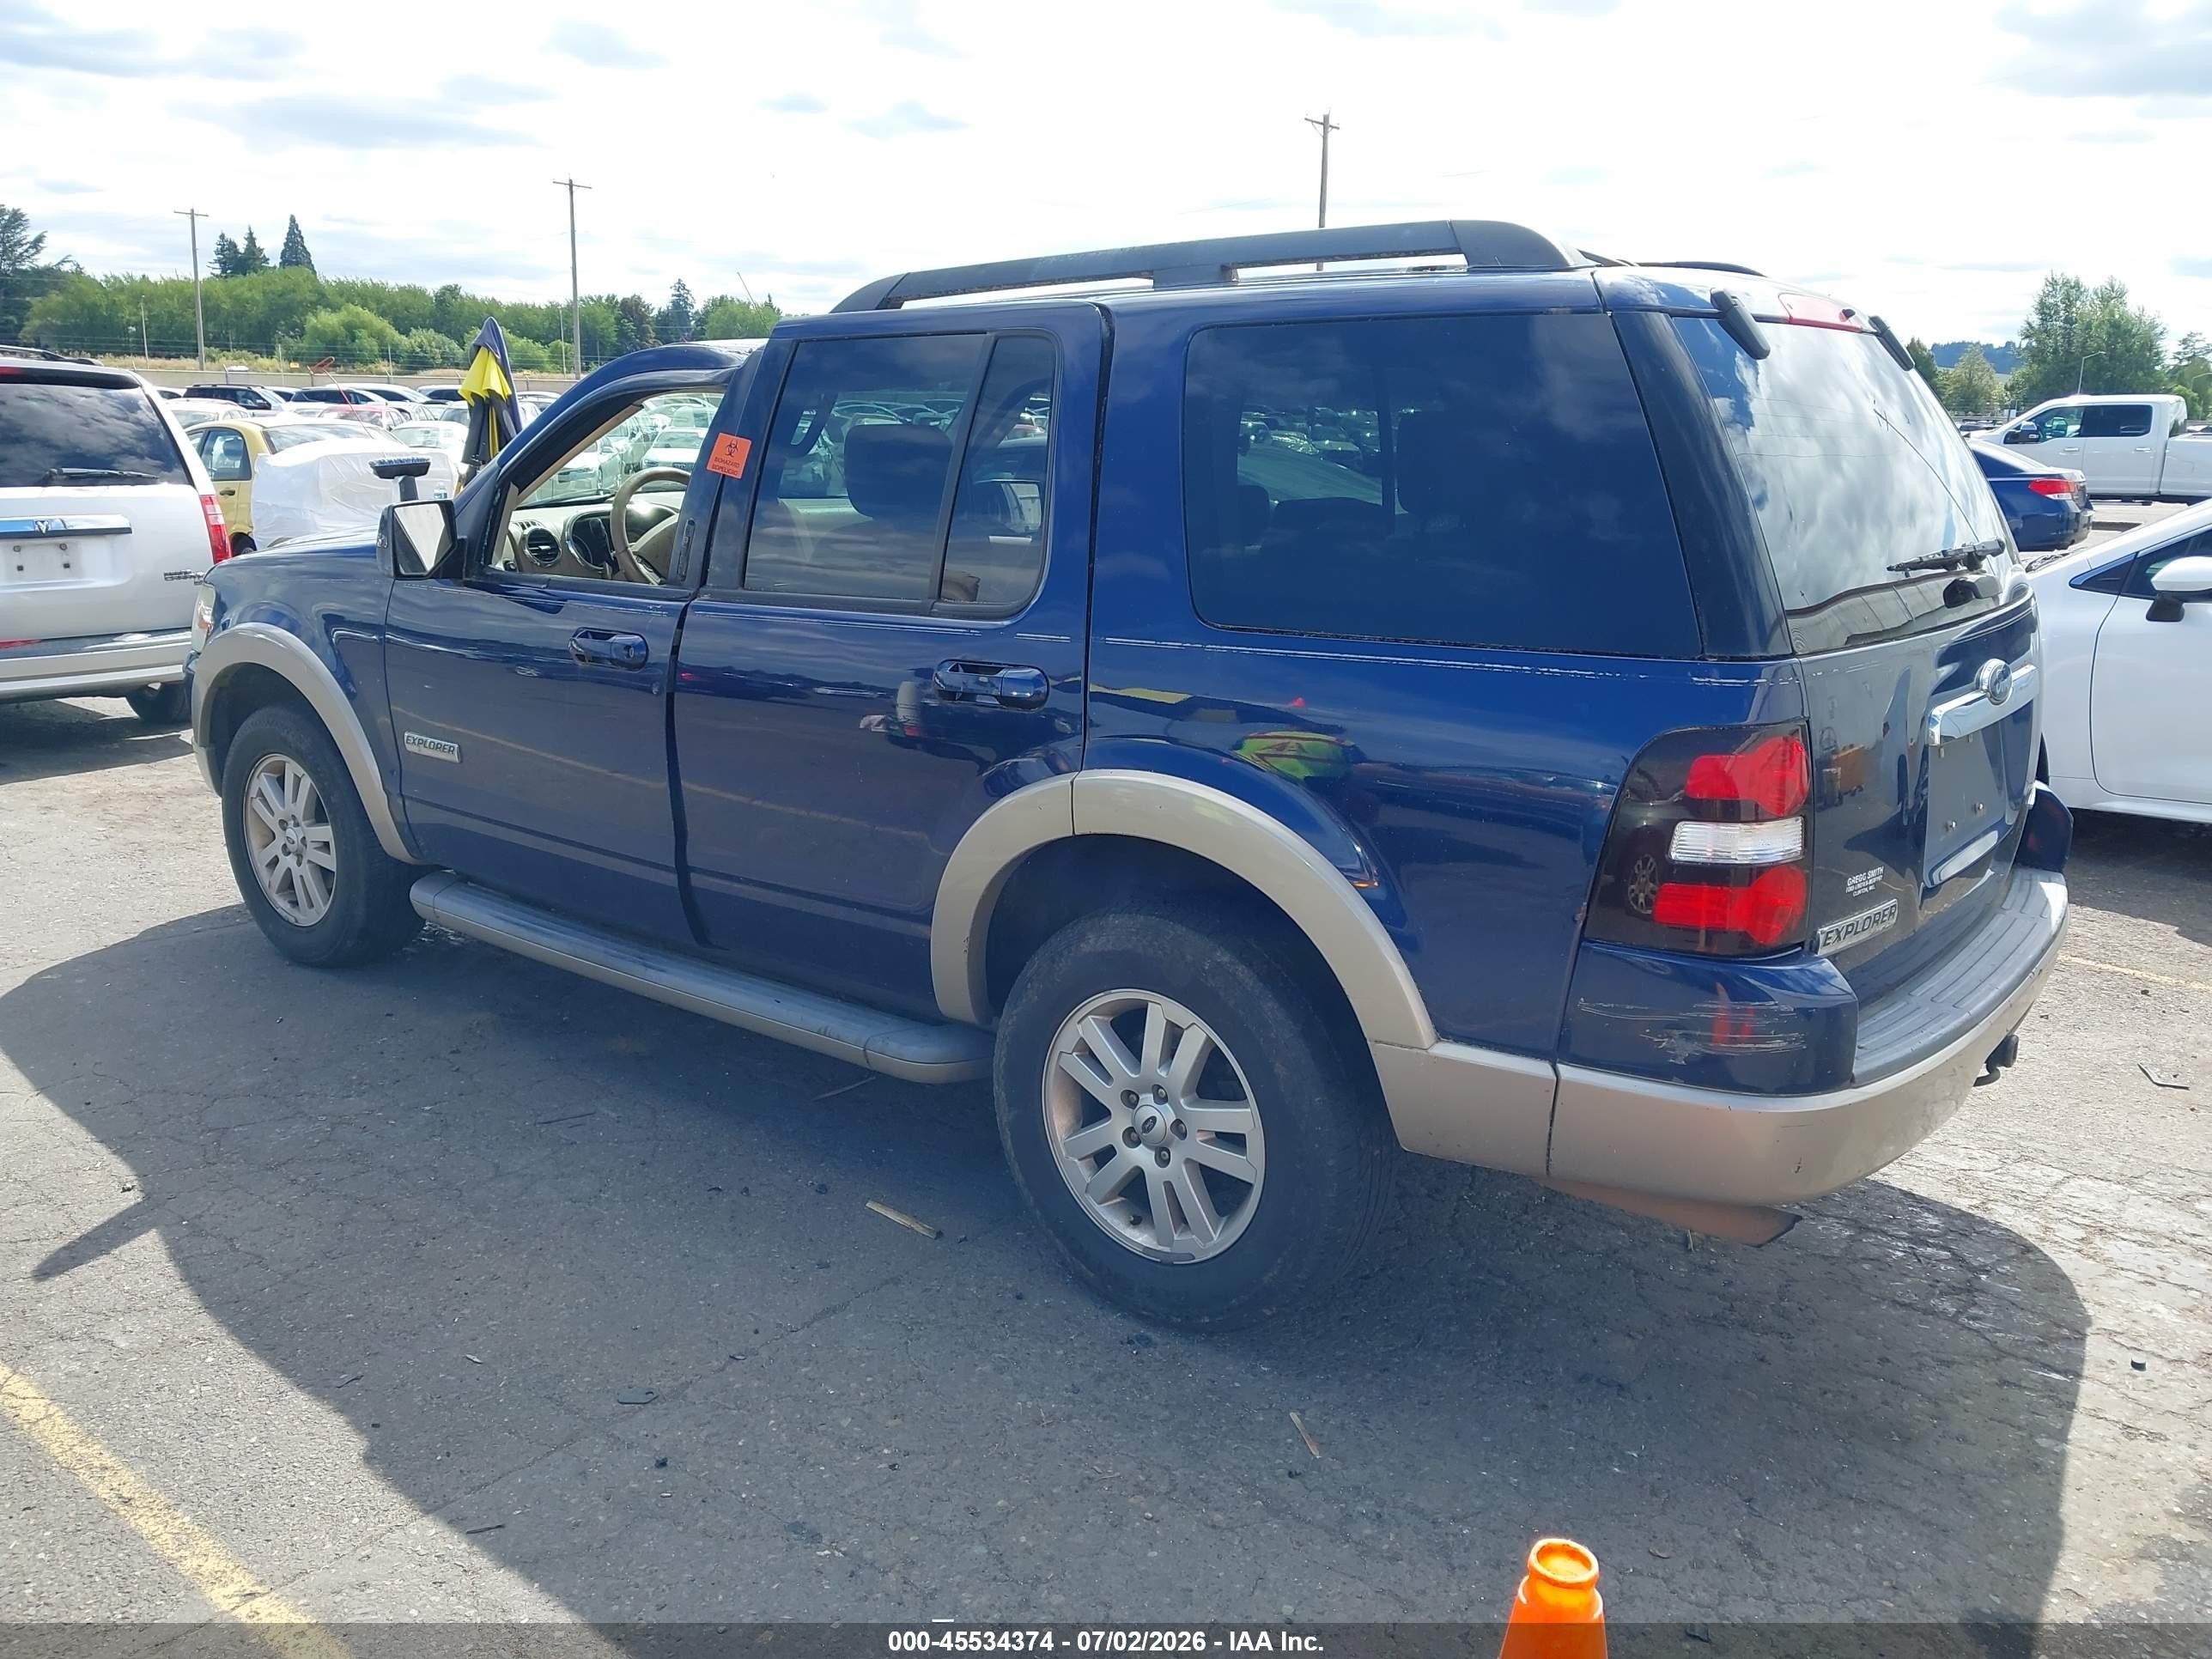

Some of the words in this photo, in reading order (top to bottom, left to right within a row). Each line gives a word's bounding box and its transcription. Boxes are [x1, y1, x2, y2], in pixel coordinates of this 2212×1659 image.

[714, 456, 739, 468] BIOHAZARD
[405, 735, 455, 755] EXPLORER
[1847, 872, 1867, 886] GREGG
[1867, 866, 1884, 879] SMITH
[1822, 904, 1897, 947] EXPLORER
